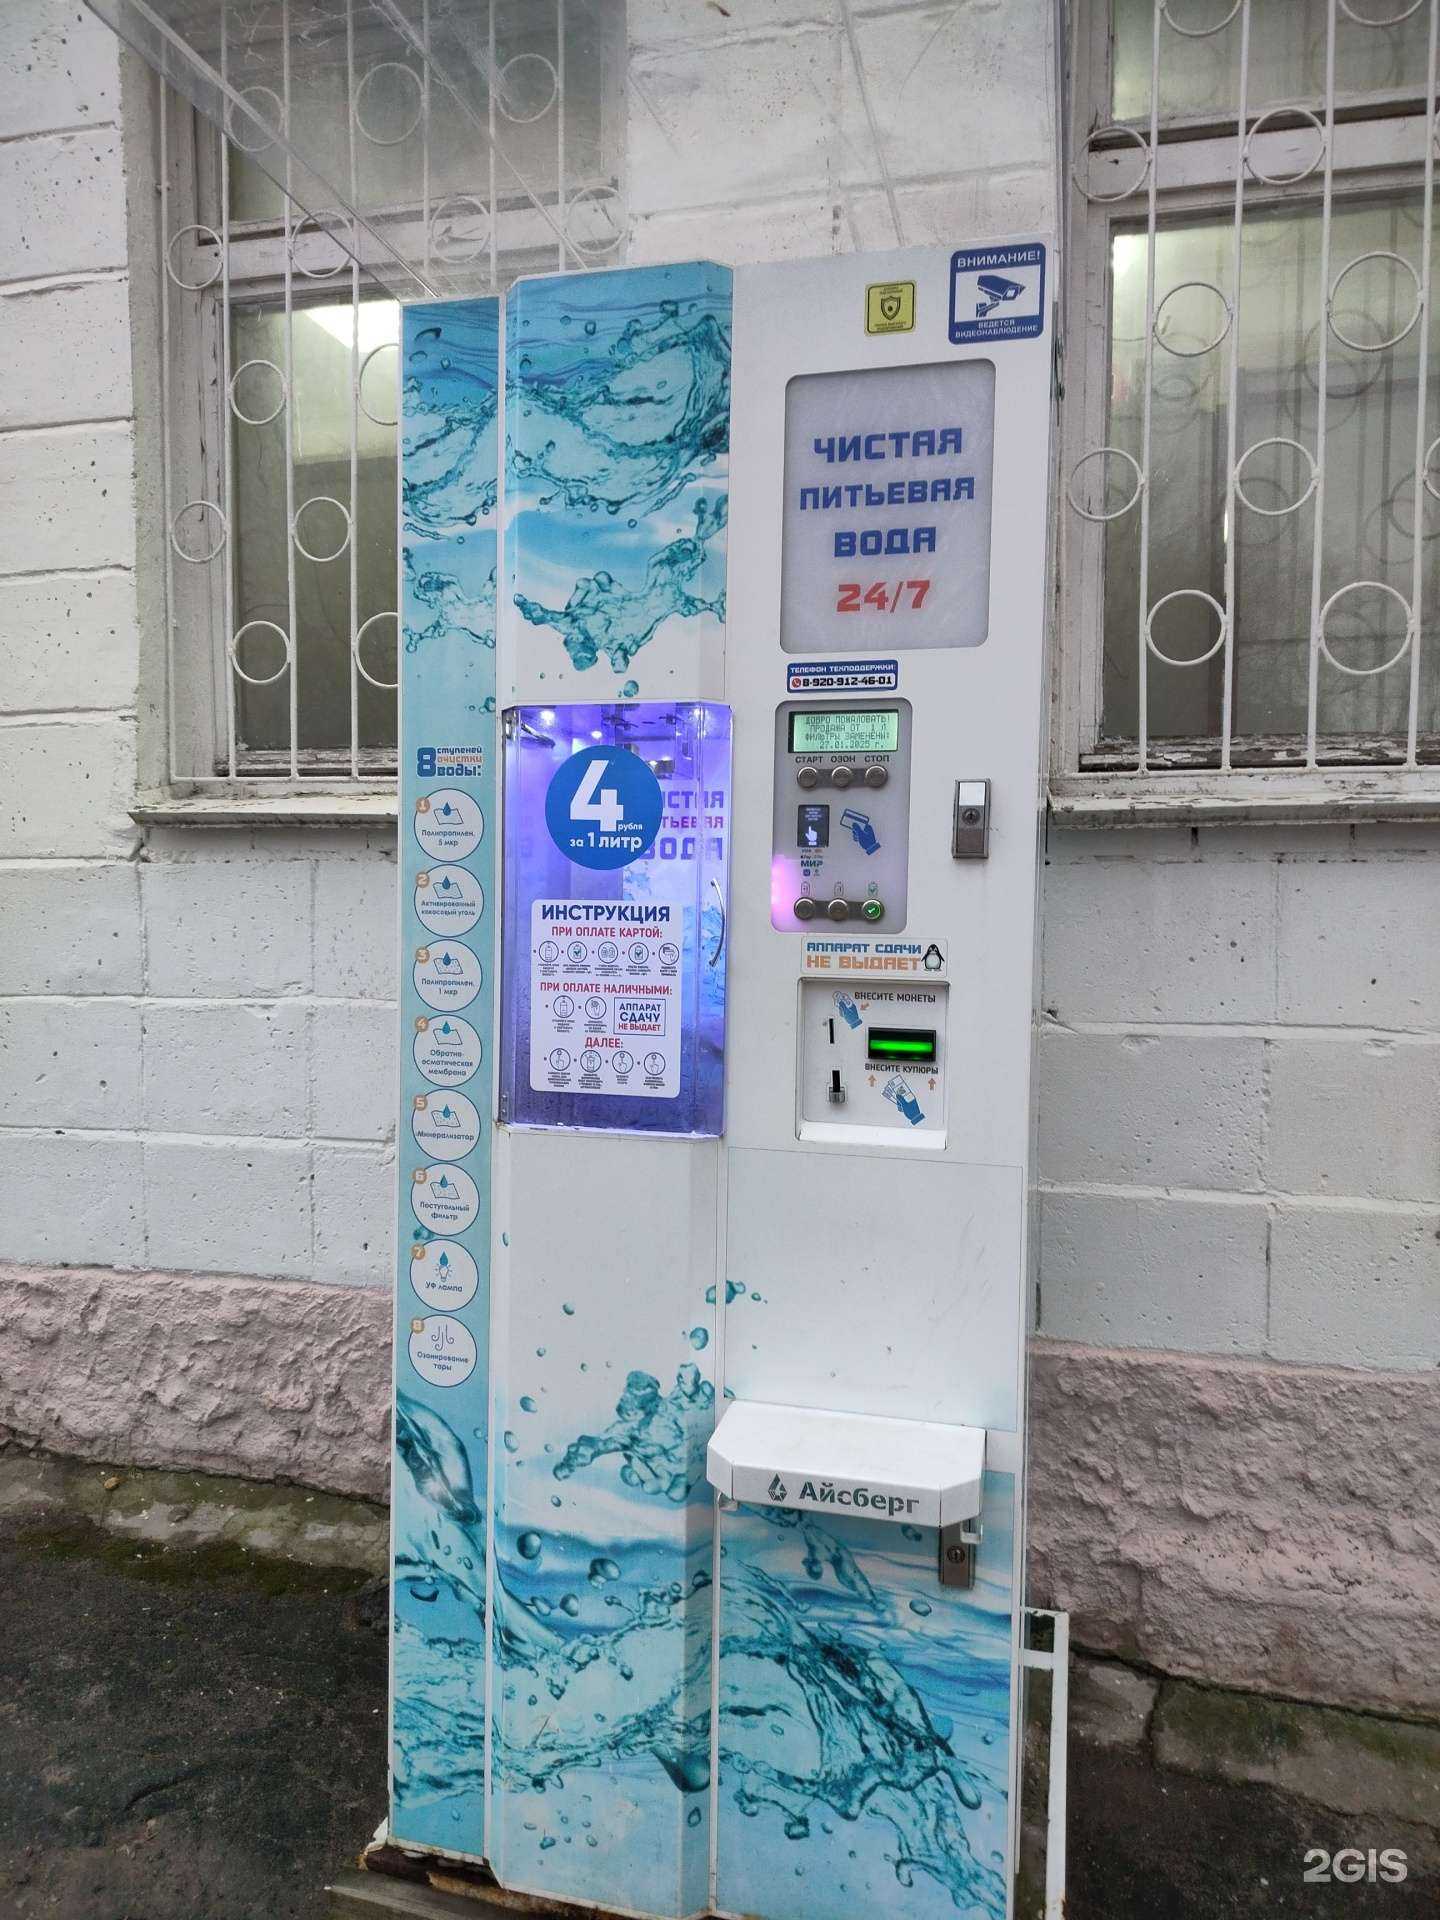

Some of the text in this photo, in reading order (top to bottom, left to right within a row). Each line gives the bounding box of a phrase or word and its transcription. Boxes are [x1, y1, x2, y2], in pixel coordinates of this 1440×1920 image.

[957, 251, 1041, 268] ВНИМАНИЕ!
[978, 319, 1016, 328] ВЕДЕТСЯ
[955, 325, 1039, 338] ВИДЕОНАБЛЮДЕНИЕ
[814, 428, 963, 463] ЧИСТАЯ
[800, 477, 975, 511] ПИТЬЕВАЯ
[834, 527, 937, 557] ВОДА
[836, 580, 931, 613] 24/7
[790, 666, 827, 674] ТЕЛЕФОН
[802, 676, 893, 687] 8-920-912-46-01
[437, 746, 482, 755] ступеней
[417, 747, 436, 777] 8
[437, 755, 482, 764] очистки
[795, 756, 824, 764] СТАРТ
[830, 755, 856, 763] ОЗОН
[864, 755, 890, 763] СТОП
[437, 764, 481, 776] воды:
[570, 760, 624, 831] 4
[618, 822, 643, 831] рубля
[444, 840, 459, 848] мкр
[570, 832, 643, 852] за 1 литр
[542, 904, 670, 924] ИНСТРУКЦИЯ
[551, 926, 663, 938] ПРИ ОПЛАТЕ КАРТОЙ:
[807, 942, 922, 955] АППАРАТ СДАЧИ
[807, 955, 922, 971] НЕ ВЫДАЕТ
[540, 982, 673, 995] ПРИ ОПЛАТЕ НАЛИЧНЫМИ:
[854, 991, 937, 1003] ВНЕСИТЕ МОНЕТЫ
[619, 1003, 661, 1012] АППАРАТ
[619, 1012, 661, 1024] СДАЧУ
[618, 1022, 661, 1032] НЕ ВЫДАЕТ
[585, 1037, 624, 1048] ДАЛЕЕ:
[428, 1068, 467, 1076] мембрана
[865, 1063, 939, 1075] ВНЕСИТЕ КУПЮРЫ
[416, 1130, 474, 1141] Минерализатор
[420, 1201, 470, 1212] Постугольный
[430, 1212, 458, 1221] фильтр
[438, 1284, 463, 1292] лампа
[417, 1351, 469, 1363] Озонирование
[433, 1363, 452, 1371] тары
[799, 1481, 920, 1516] Айсберг
